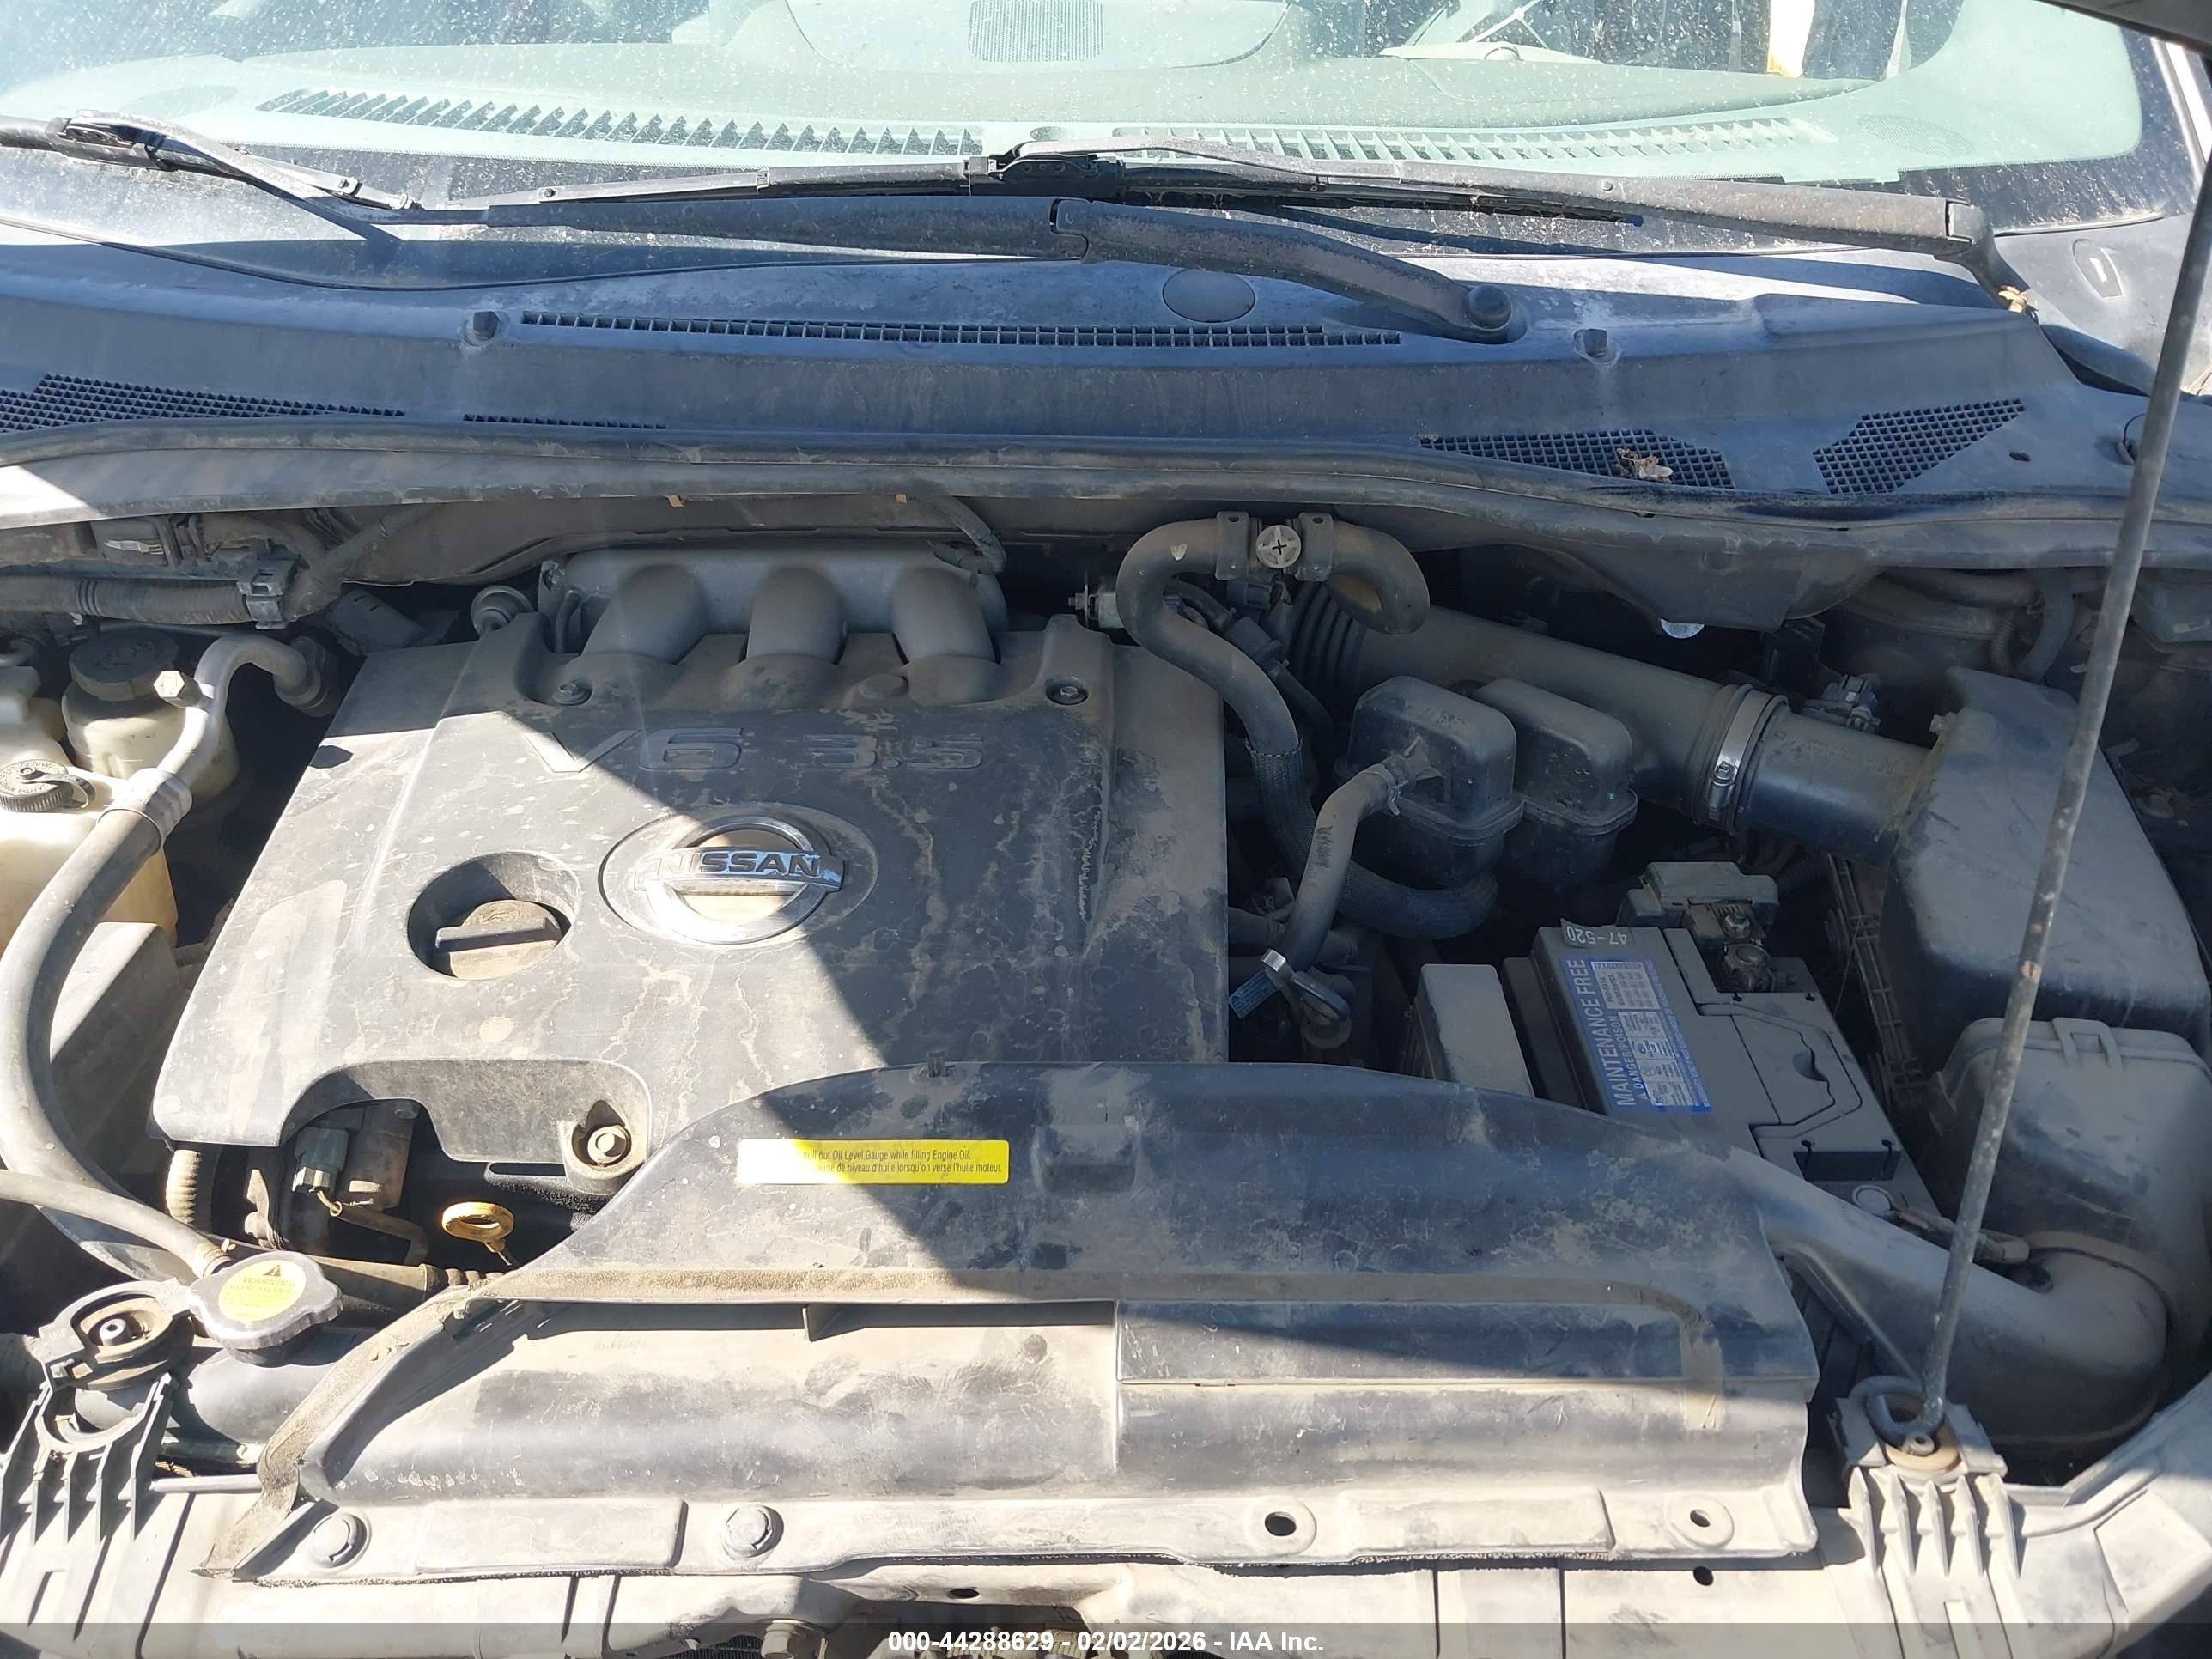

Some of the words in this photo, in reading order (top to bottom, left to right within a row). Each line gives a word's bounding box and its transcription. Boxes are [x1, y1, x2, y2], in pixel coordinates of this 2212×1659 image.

[522, 727, 744, 773] V6
[798, 733, 984, 770] 3.5
[660, 851, 822, 878] NISSAN
[1566, 925, 1627, 945] 47-520
[1565, 959, 1596, 994] FREE
[1579, 998, 1636, 1105] MAINTENANCE
[818, 1150, 830, 1160] out
[832, 1149, 842, 1160] Oil
[845, 1149, 863, 1160] Level
[866, 1149, 889, 1162] Gauge
[890, 1149, 908, 1159] while
[911, 1149, 931, 1162] filling
[933, 1149, 957, 1162] Engine
[959, 1149, 970, 1160] Oil.
[836, 1163, 846, 1172] de
[848, 1163, 869, 1172] niveau
[872, 1163, 895, 1172] d'huile
[896, 1162, 930, 1174] lorsqu'on
[933, 1164, 951, 1172] verse
[953, 1163, 974, 1172] l'huile
[976, 1164, 1002, 1172] moteur.
